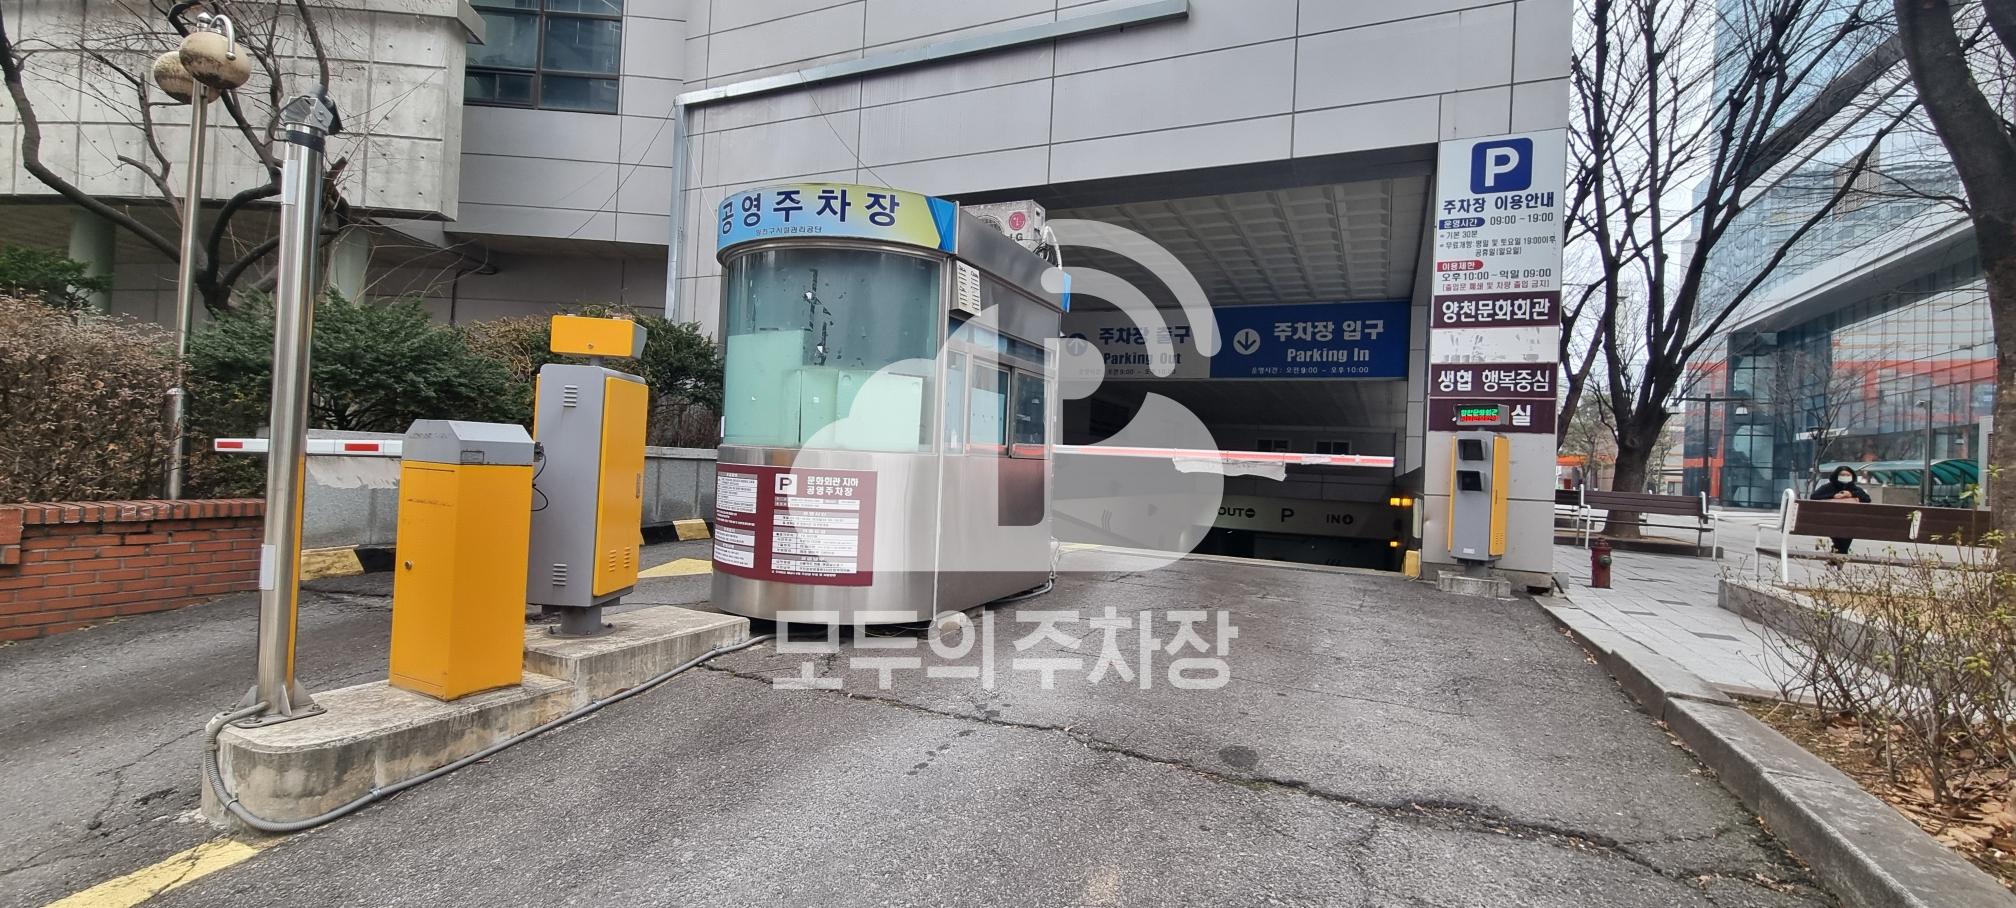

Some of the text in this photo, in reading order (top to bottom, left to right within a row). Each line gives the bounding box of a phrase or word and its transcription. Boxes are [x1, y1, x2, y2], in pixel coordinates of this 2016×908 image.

[1485, 146, 1520, 187] P
[1443, 192, 1555, 214] 주차장 이용안내
[722, 188, 900, 235] 공영주차장
[1444, 219, 1478, 229] 운영시간
[1490, 214, 1516, 225] 09:00
[1528, 212, 1554, 222] 19:00
[1446, 230, 1478, 239] 기본 30분
[1475, 239, 1489, 248] 평일
[1492, 239, 1498, 247] 및
[1501, 237, 1521, 246] 토요일
[1442, 261, 1475, 270] 이용제한
[1499, 269, 1520, 279] 익일
[1523, 268, 1552, 278] 09:00
[1487, 282, 1494, 290] 및
[1496, 280, 1511, 290] 차량
[1514, 280, 1528, 289] 출입
[1442, 298, 1551, 323] 양천문화회관
[1100, 325, 1191, 345] 주차장 출구
[1273, 319, 1384, 342] 주차장 입구
[1104, 352, 1182, 365] Parking Out
[1287, 348, 1370, 363] Parking In
[1438, 369, 1549, 392] 생협 행복중심
[779, 477, 792, 491] P
[807, 476, 859, 487] 문화회관 지하
[806, 485, 853, 496] 공영주차장
[1281, 508, 1294, 522] P
[1326, 513, 1340, 524] IN
